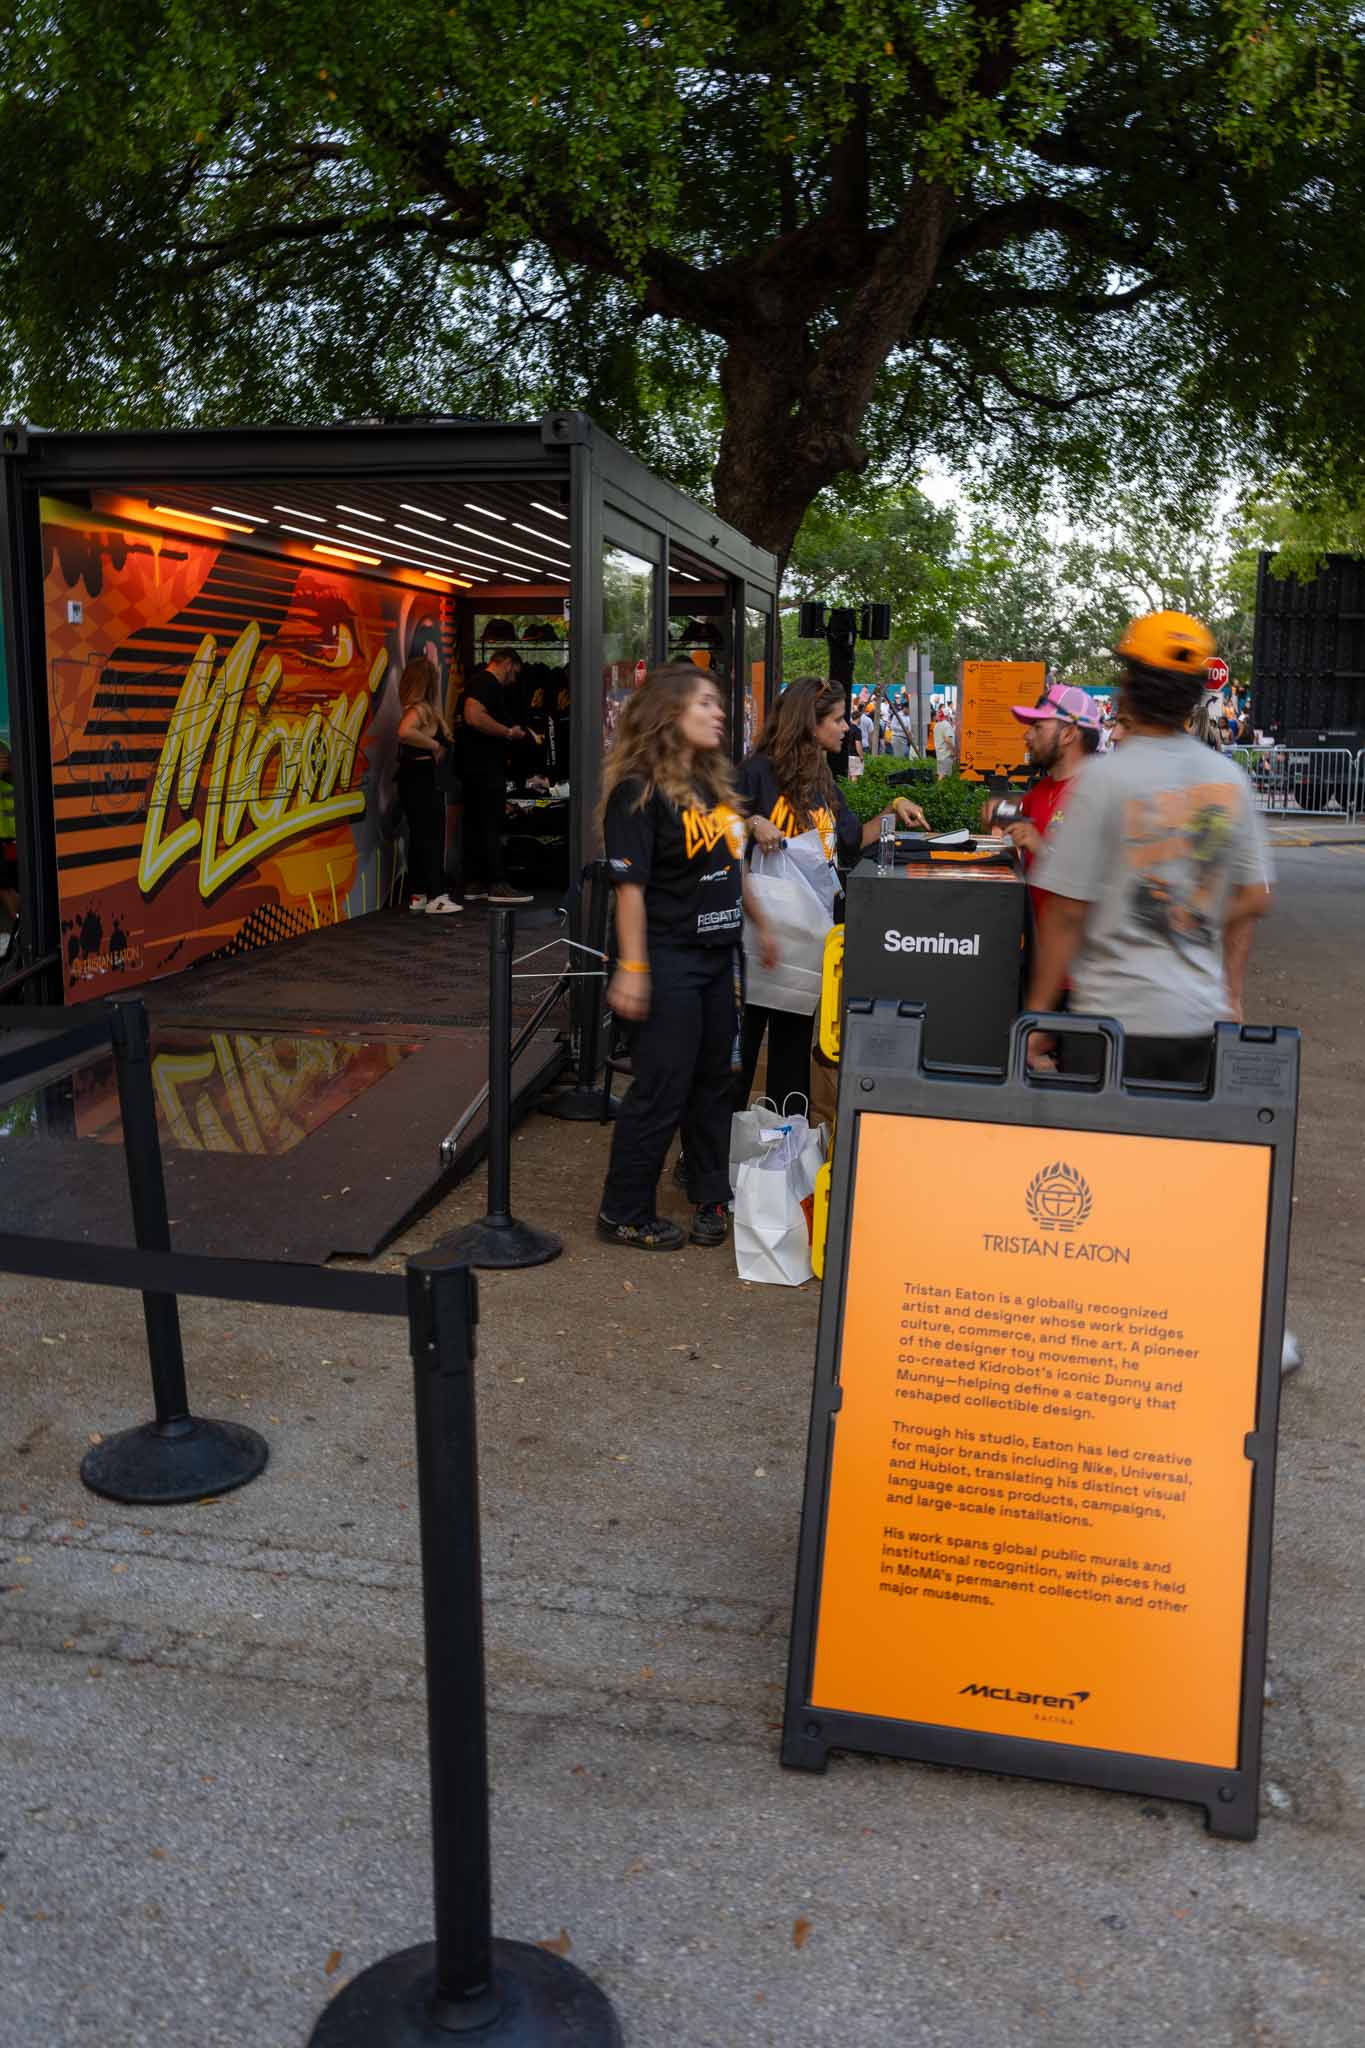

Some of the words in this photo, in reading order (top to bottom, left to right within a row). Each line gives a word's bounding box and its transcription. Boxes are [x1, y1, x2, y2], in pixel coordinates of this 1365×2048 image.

[884, 929, 981, 956] Seminal
[982, 1233, 1058, 1256] TRISTAN
[1063, 1241, 1130, 1264] EATON
[903, 1281, 951, 1297] Tristan
[955, 1287, 994, 1301] Eaton
[999, 1291, 1010, 1304] is
[1014, 1296, 1022, 1304] a
[1026, 1295, 1083, 1314] globally
[1087, 1303, 1168, 1319] recognized
[900, 1319, 954, 1334] culture,
[958, 1325, 1035, 1342] commerce,
[1039, 1333, 1066, 1344] and
[1071, 1334, 1098, 1348] fine
[1101, 1340, 1126, 1350] art.
[1130, 1340, 1139, 1352] A
[1143, 1343, 1199, 1358] pioneer
[901, 1301, 939, 1314] artist
[943, 1306, 970, 1317] and
[974, 1308, 1035, 1324] designer
[1039, 1315, 1085, 1328] whose
[1089, 1321, 1122, 1331] work
[1128, 1324, 1184, 1340] bridges
[898, 1335, 913, 1345] of
[918, 1336, 941, 1349] the
[945, 1339, 1006, 1356] designer
[1011, 1347, 1034, 1361] toy
[1039, 1351, 1117, 1368] movement,
[1121, 1358, 1138, 1370] he
[897, 1353, 975, 1370] co-created
[1056, 1368, 1099, 1383] iconic
[1104, 1373, 1151, 1392] Dunny
[1154, 1381, 1183, 1392] and
[895, 1387, 960, 1404] reshaped
[963, 1396, 1039, 1413] collectible
[1042, 1403, 1094, 1420] design.
[1014, 1383, 1059, 1397] define
[1063, 1389, 1071, 1398] a
[1075, 1391, 1141, 1409] category
[1146, 1396, 1176, 1409] that
[891, 1437, 911, 1450] for
[915, 1444, 954, 1457] major
[958, 1446, 1007, 1462] brands
[1012, 1452, 1078, 1474] including
[1082, 1460, 1116, 1476] Nike,
[1121, 1466, 1192, 1485] Universal,
[892, 1420, 950, 1440] Through
[954, 1427, 975, 1440] his
[979, 1431, 1028, 1448] studio,
[1031, 1436, 1073, 1451] Eaton
[1077, 1441, 1103, 1455] has
[1107, 1445, 1128, 1458] led
[1132, 1450, 1192, 1466] creative
[887, 1473, 953, 1493] language
[956, 1484, 1004, 1498] across
[1007, 1490, 1077, 1508] products,
[1081, 1499, 1165, 1519] campaigns,
[888, 1458, 916, 1469] and
[919, 1459, 970, 1477] Hublot,
[975, 1466, 1053, 1488] translating
[1057, 1476, 1078, 1488] his
[1082, 1480, 1138, 1496] distinct
[1143, 1487, 1185, 1501] visual
[885, 1492, 913, 1504] and
[916, 1495, 996, 1515] large-scale
[999, 1505, 1092, 1526] installations.
[881, 1543, 969, 1565] institutional
[973, 1559, 1060, 1578] recognition,
[1065, 1570, 1096, 1581] with
[1100, 1573, 1149, 1589] pieces
[1153, 1579, 1185, 1594] held
[883, 1525, 905, 1539] His
[907, 1532, 944, 1544] work
[946, 1536, 989, 1550] spans
[992, 1540, 1037, 1556] global
[1040, 1548, 1086, 1562] public
[1089, 1555, 1139, 1569] murals
[1142, 1561, 1171, 1573] and
[879, 1582, 918, 1596] major
[922, 1587, 994, 1605] museums.
[880, 1561, 893, 1573] in
[955, 1573, 1034, 1592] permanent
[1038, 1584, 1111, 1602] collection
[1114, 1595, 1143, 1607] and
[1146, 1599, 1188, 1612] other
[959, 1684, 1076, 1710] McLaren
